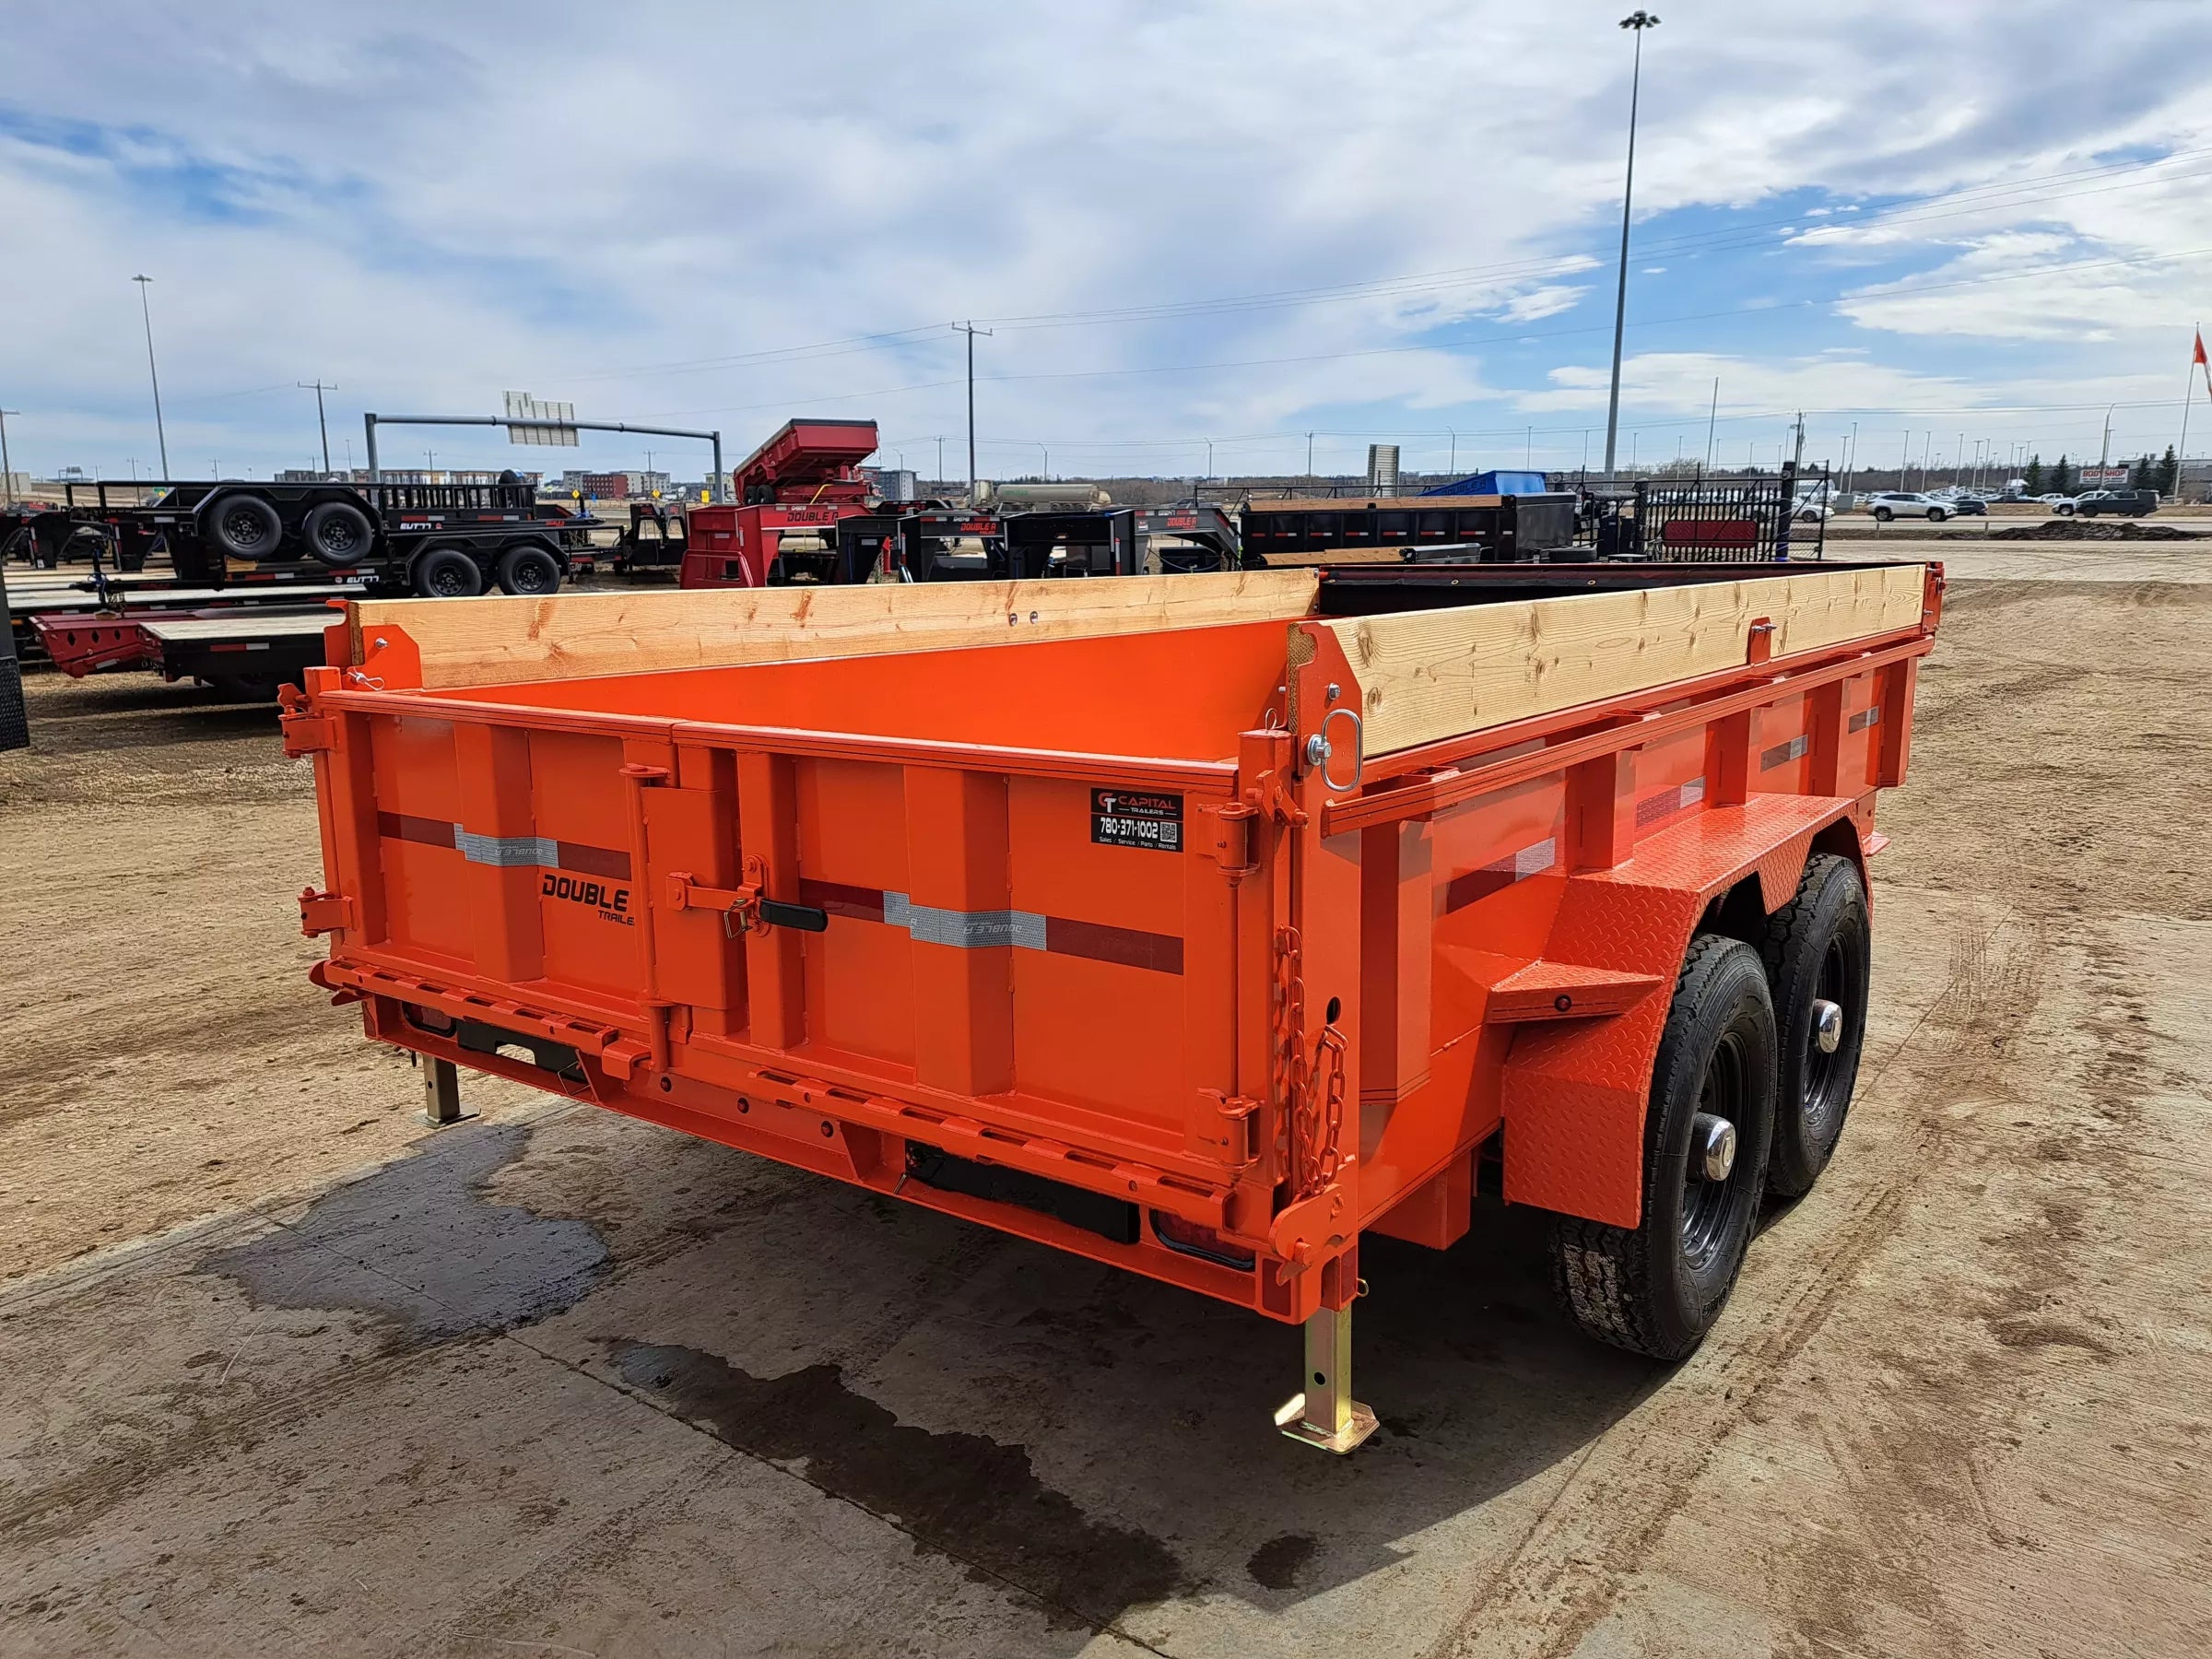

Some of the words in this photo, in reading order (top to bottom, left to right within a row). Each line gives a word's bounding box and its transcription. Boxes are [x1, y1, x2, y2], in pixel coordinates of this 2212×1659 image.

[2104, 469, 2125, 477] SHOP
[787, 512, 830, 522] DOUBLE
[1167, 517, 1191, 527] DOUBLE
[960, 523, 990, 531] DOUBLE
[1118, 795, 1177, 809] CAPITAL
[1131, 807, 1164, 816] TRAILERS
[1100, 817, 1159, 839] 780-371-1002
[1118, 838, 1135, 846] Service
[1159, 842, 1177, 851] Rentals
[543, 874, 629, 912] DOUBLE
[975, 924, 1023, 935] DOUBLE
